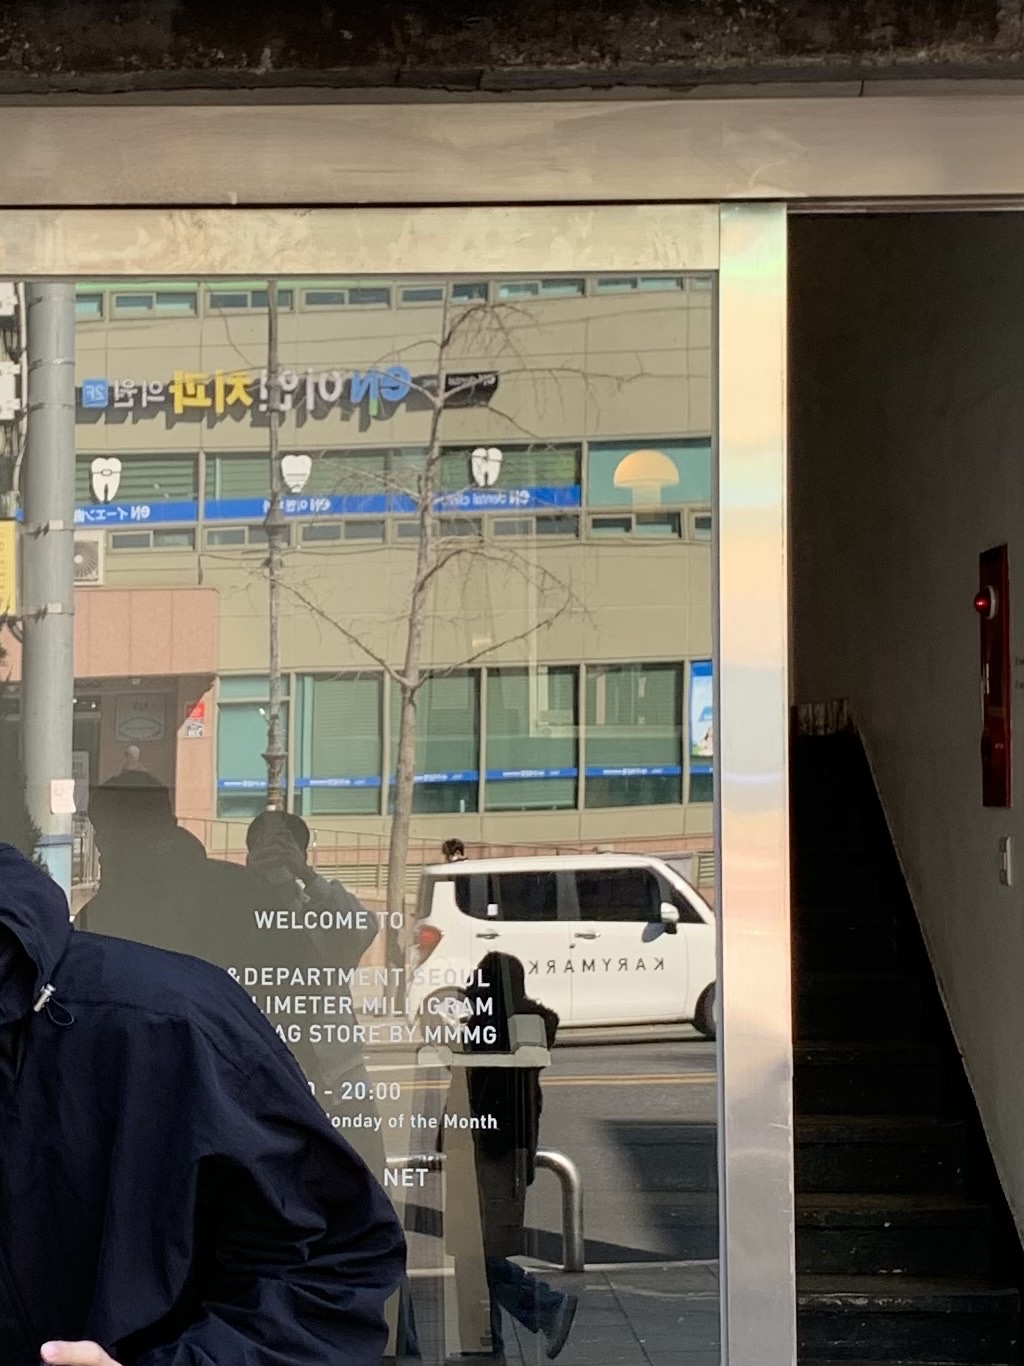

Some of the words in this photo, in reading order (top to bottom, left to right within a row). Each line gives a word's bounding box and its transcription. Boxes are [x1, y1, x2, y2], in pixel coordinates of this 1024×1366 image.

[254, 911, 368, 930] WELCOME
[377, 911, 404, 929] TO
[227, 967, 404, 986] &DEPARTMENT
[413, 969, 490, 987] SEOUL
[362, 996, 494, 1016] MILLIGRAM
[309, 1024, 380, 1043] STORE
[389, 1025, 418, 1043] BY
[425, 1025, 497, 1045] MMMG
[341, 1081, 401, 1100] 20:00
[326, 1112, 383, 1132] onday
[388, 1113, 405, 1128] of
[410, 1113, 438, 1128] the
[444, 1113, 498, 1130] Month
[383, 1168, 429, 1188] NET
